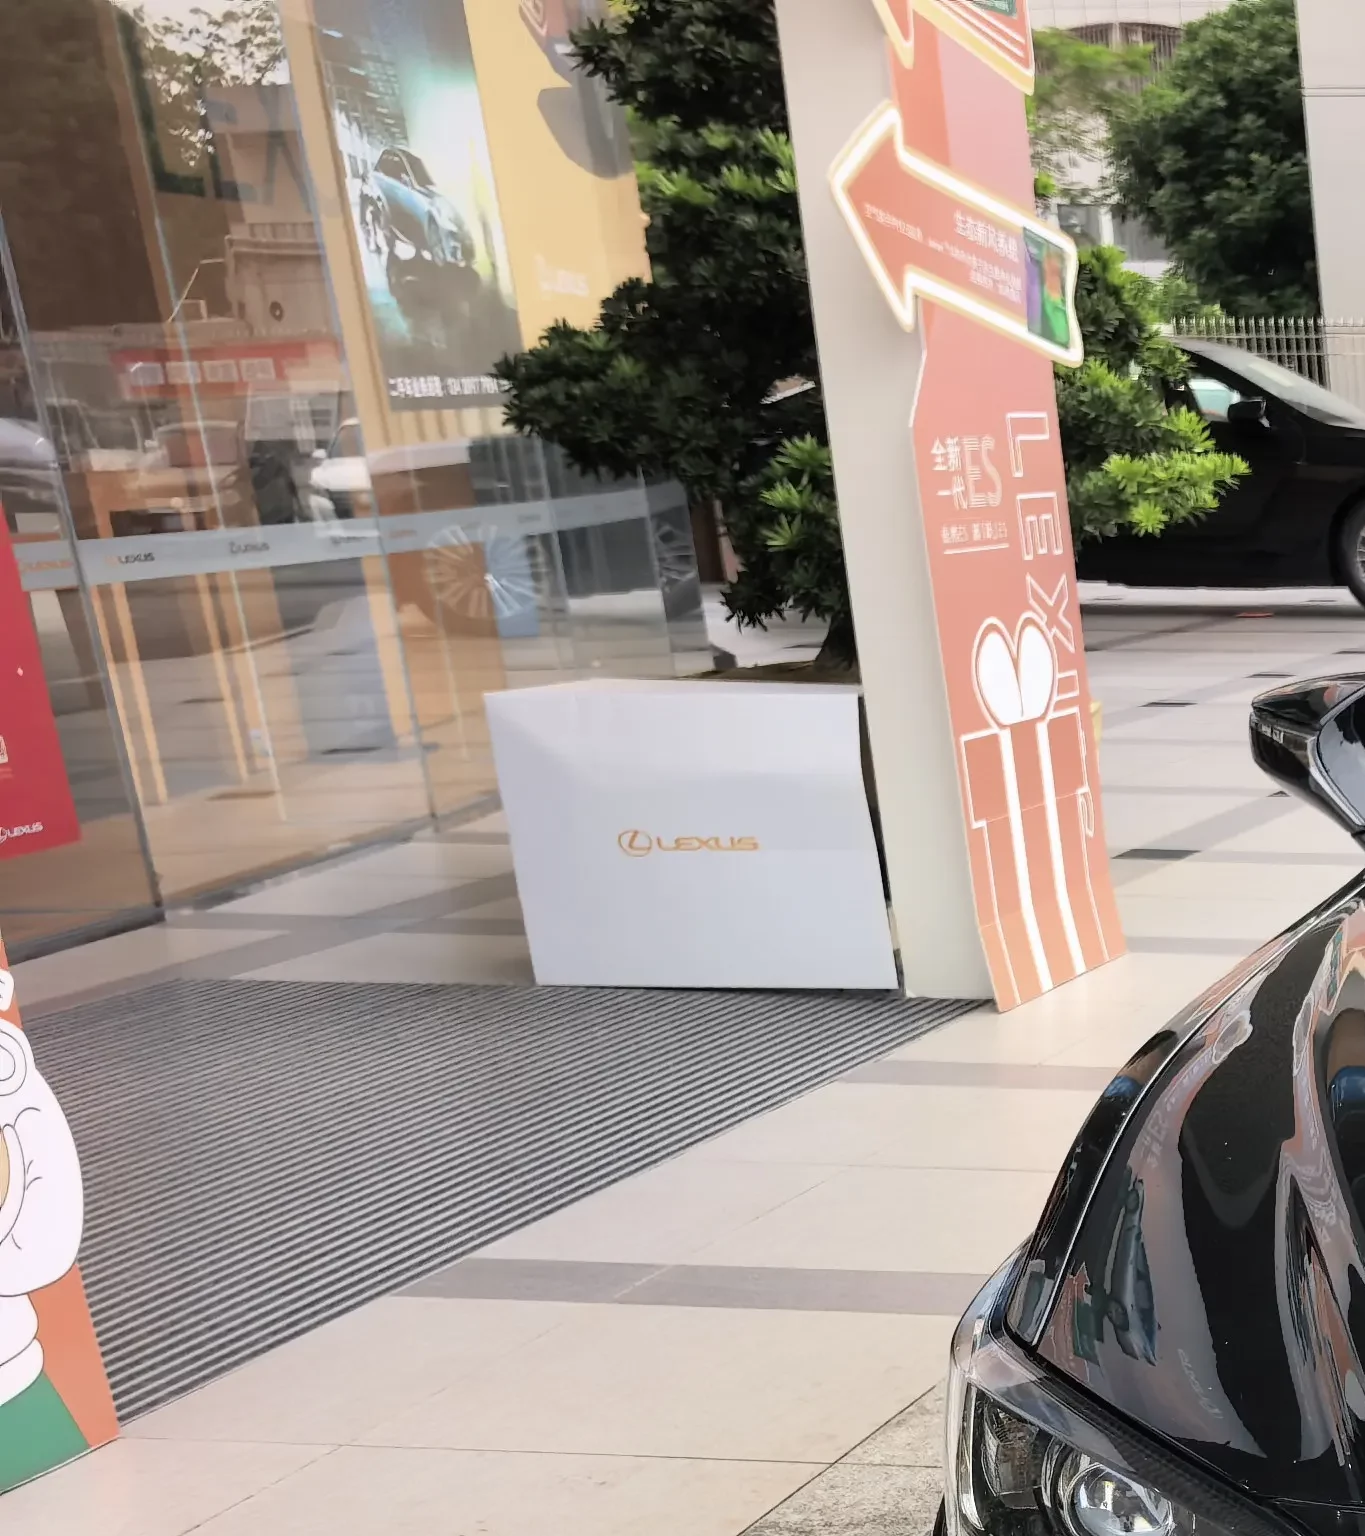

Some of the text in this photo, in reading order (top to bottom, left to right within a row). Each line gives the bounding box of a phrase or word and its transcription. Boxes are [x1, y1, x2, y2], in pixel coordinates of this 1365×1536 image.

[931, 436, 962, 472] 全新
[936, 475, 968, 510] 一代
[656, 836, 760, 851] LEXUS
